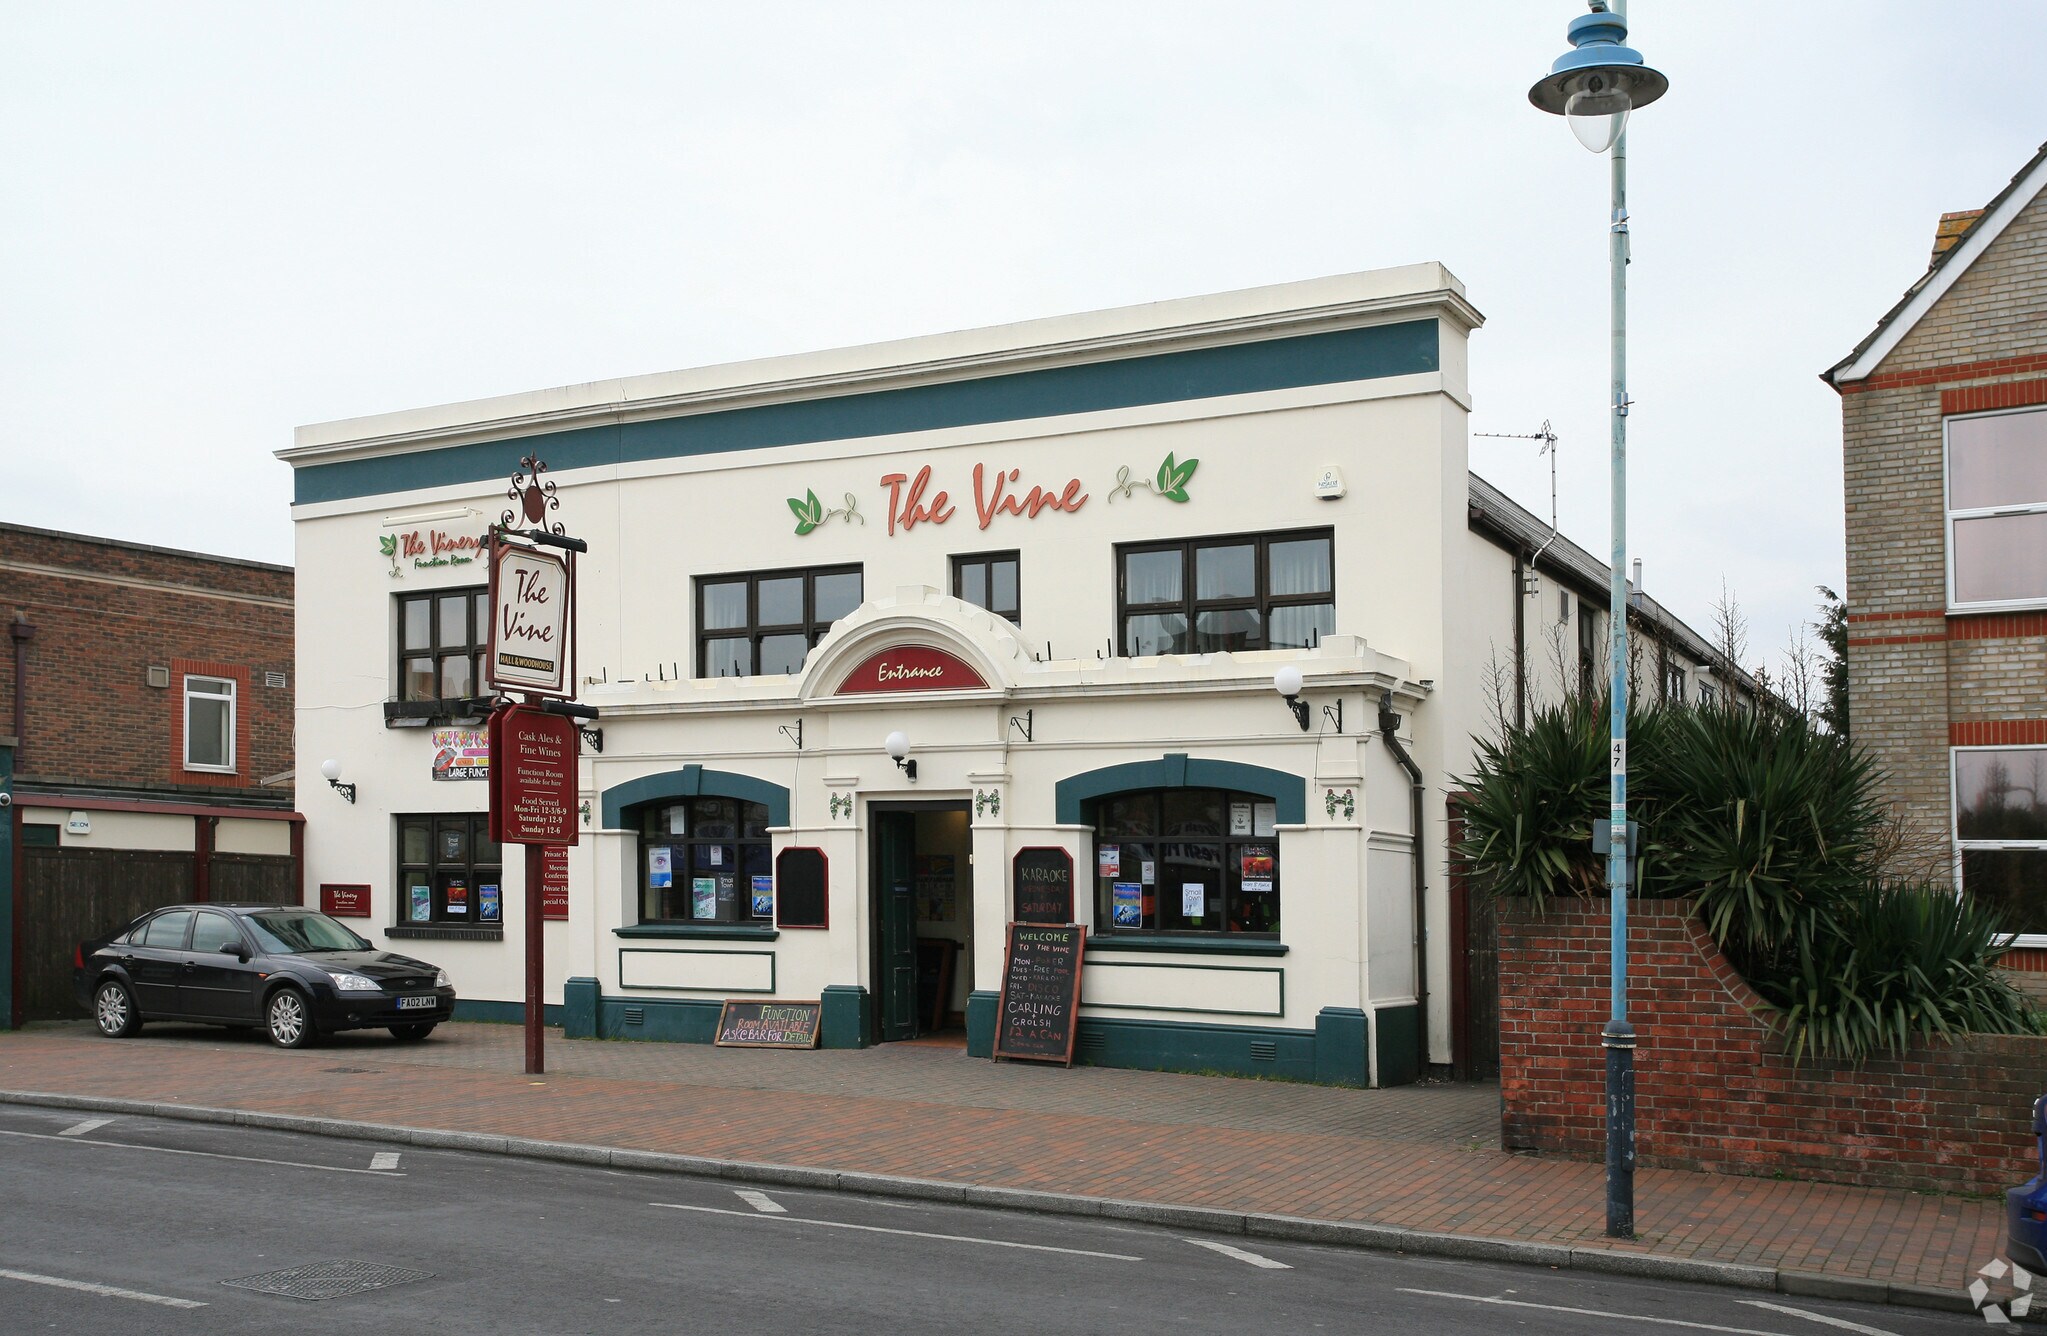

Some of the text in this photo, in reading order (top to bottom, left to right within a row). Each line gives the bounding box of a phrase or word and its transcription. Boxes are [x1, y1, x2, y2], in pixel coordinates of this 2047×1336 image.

[880, 462, 1089, 536] The Vine
[400, 529, 482, 558] The Vinery
[414, 554, 472, 570] Function Room
[515, 569, 549, 604] The
[503, 603, 554, 642] Vine
[878, 662, 944, 682] Entrance
[518, 730, 562, 745] Cask Ales &
[520, 744, 561, 757] Fine Wines
[448, 767, 468, 778] LARGE
[517, 767, 564, 778] Function Room
[519, 777, 541, 785] available
[551, 779, 561, 787] hire
[521, 796, 560, 807] Food Served
[513, 804, 567, 816] Mon-Fri 12-3/6-9
[518, 813, 563, 825] Saturday 12-9
[521, 824, 561, 836] Sunday 12-6
[544, 850, 561, 858] Private
[1021, 867, 1068, 882] KARAOKE
[333, 890, 358, 901] The Vinery
[1021, 902, 1062, 913] SATURDAY
[1019, 932, 1069, 942] WELCOME
[1018, 943, 1070, 954] TO THE VINE
[1033, 964, 1050, 974] FREE
[1028, 982, 1059, 994] DISCO
[401, 997, 420, 1008] FA02
[1008, 1001, 1062, 1016] CARLING
[760, 1005, 811, 1021] FUNCTION
[737, 1018, 811, 1034] ROOM AVAILABLE
[1012, 1017, 1051, 1028] GROLSH
[748, 1028, 766, 1040] BAR
[767, 1030, 782, 1041] FOR
[782, 1031, 813, 1043] DETAILS
[1029, 1030, 1037, 1039] A
[1040, 1029, 1062, 1041] CAN
